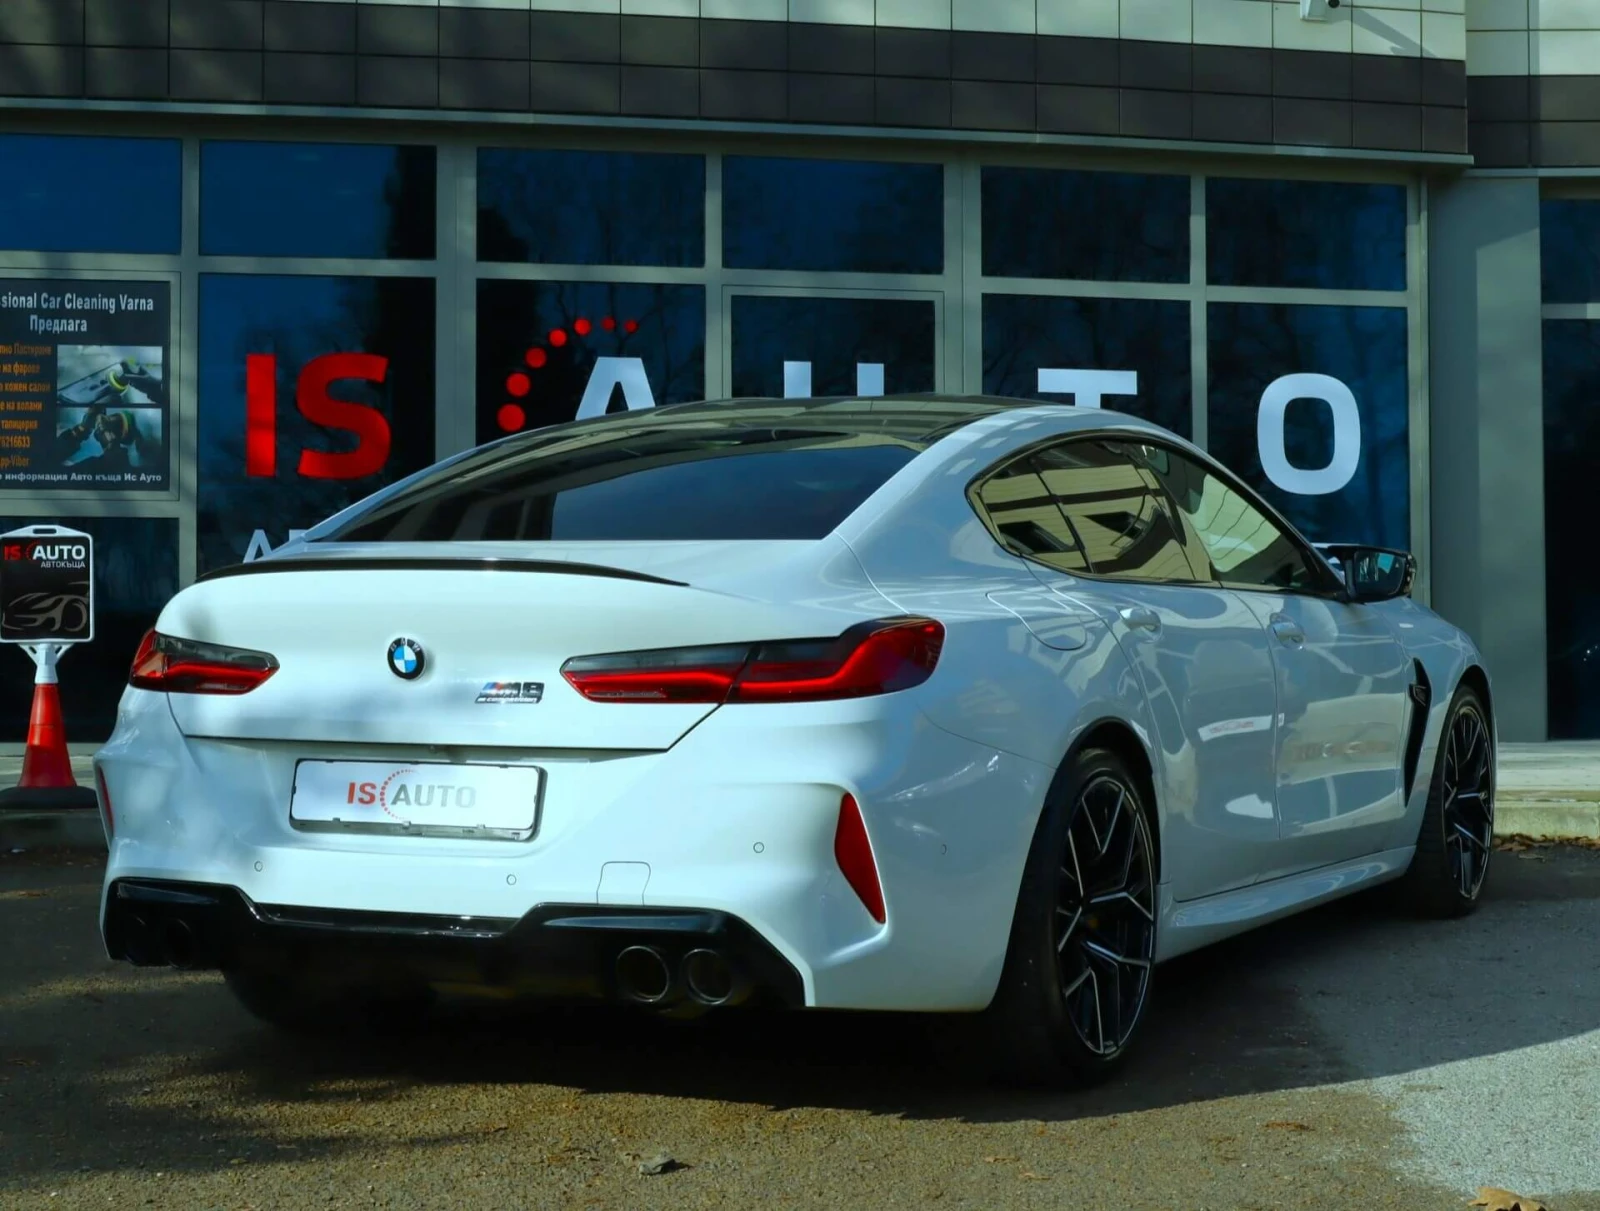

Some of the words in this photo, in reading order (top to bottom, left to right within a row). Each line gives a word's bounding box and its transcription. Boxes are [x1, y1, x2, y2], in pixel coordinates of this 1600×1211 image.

[0, 292, 37, 309] sional
[41, 292, 62, 309] Car
[64, 293, 116, 314] Cleaning
[119, 294, 154, 311] Varna
[29, 314, 88, 335] Предлага
[245, 352, 392, 480] IS
[0, 454, 29, 470] pp-Viber
[5, 471, 67, 483] информация
[70, 472, 93, 482] Авто
[95, 473, 121, 484] къща
[123, 472, 137, 482] Ис
[139, 473, 162, 484] Ауто
[4, 545, 21, 560] IS
[32, 545, 86, 560] AUTO
[40, 561, 86, 569] АВТОКЪЩА
[346, 781, 377, 805] IS
[391, 783, 477, 809] AUTO
